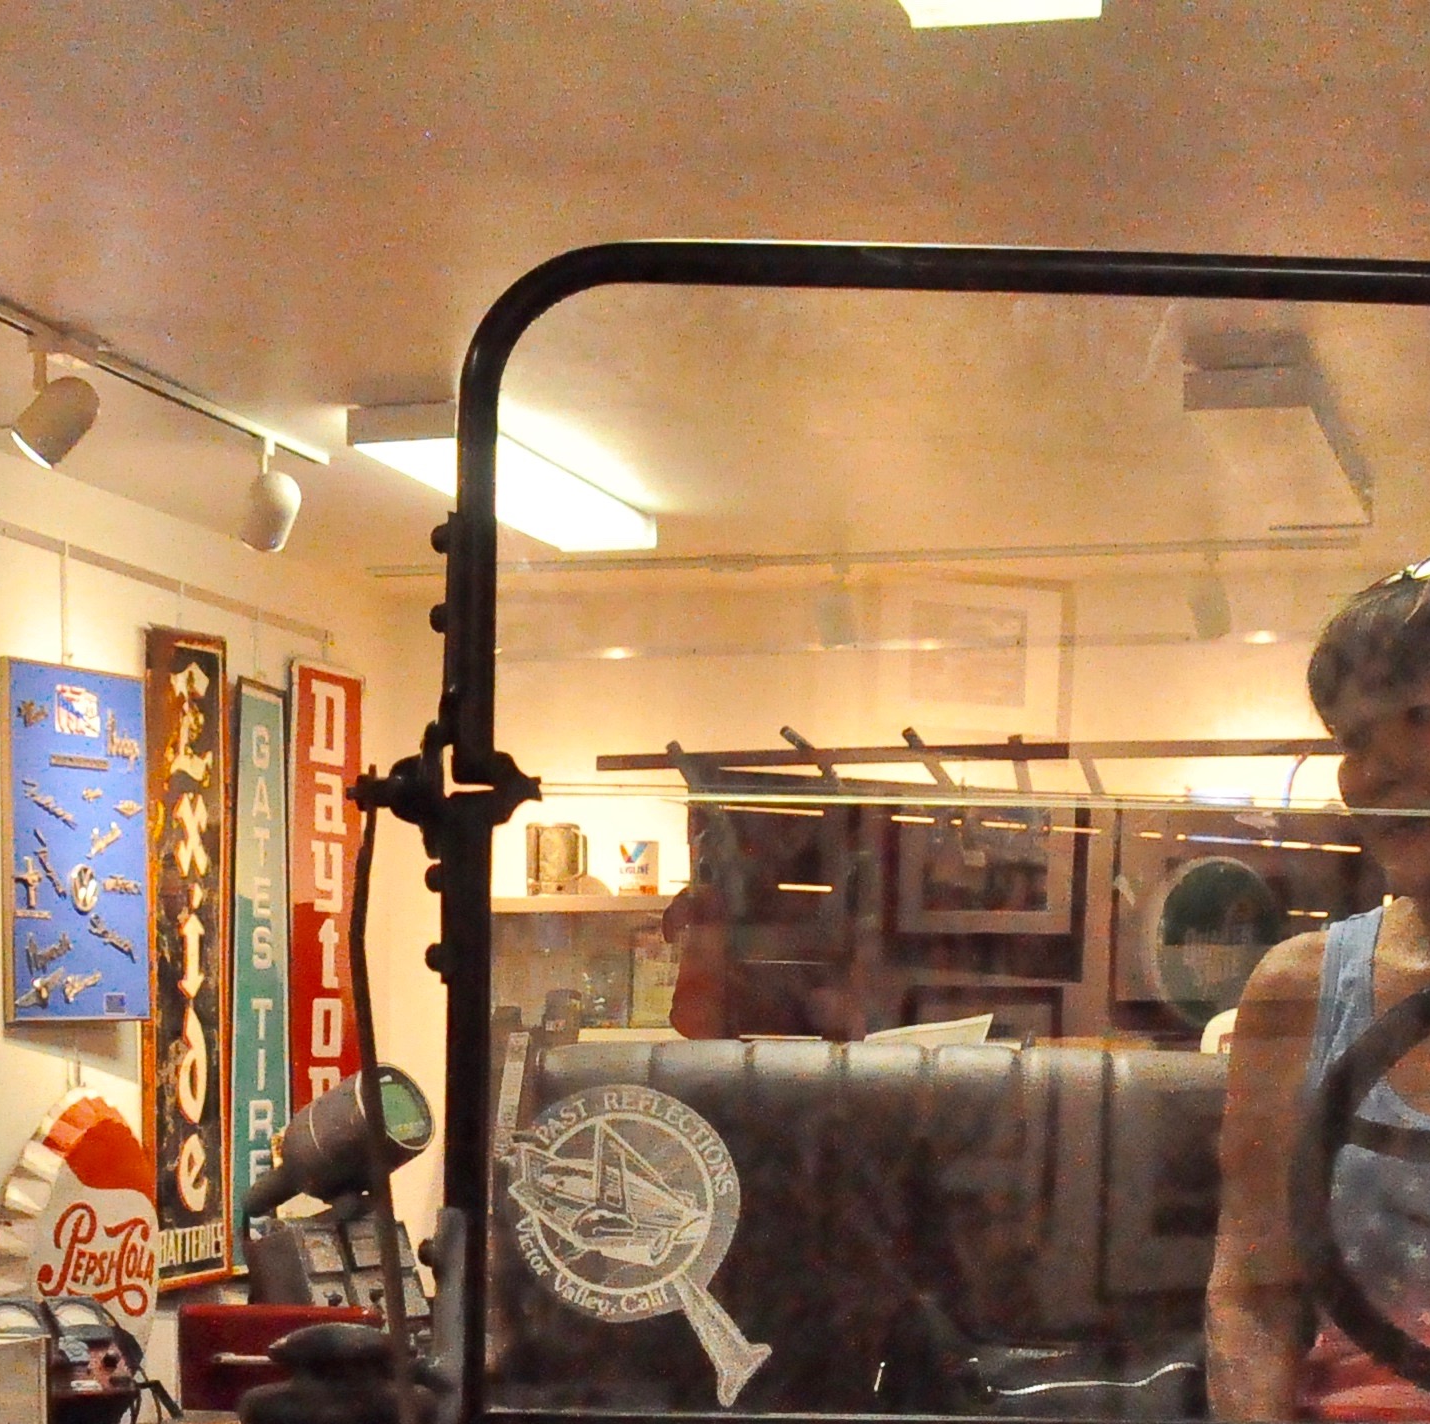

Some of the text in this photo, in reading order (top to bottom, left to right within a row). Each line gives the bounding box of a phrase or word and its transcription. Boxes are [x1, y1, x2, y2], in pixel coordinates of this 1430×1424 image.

[247, 724, 272, 971] GATES
[534, 1091, 735, 1198] PAST REFLECTIONS
[515, 1216, 551, 1277] Victor
